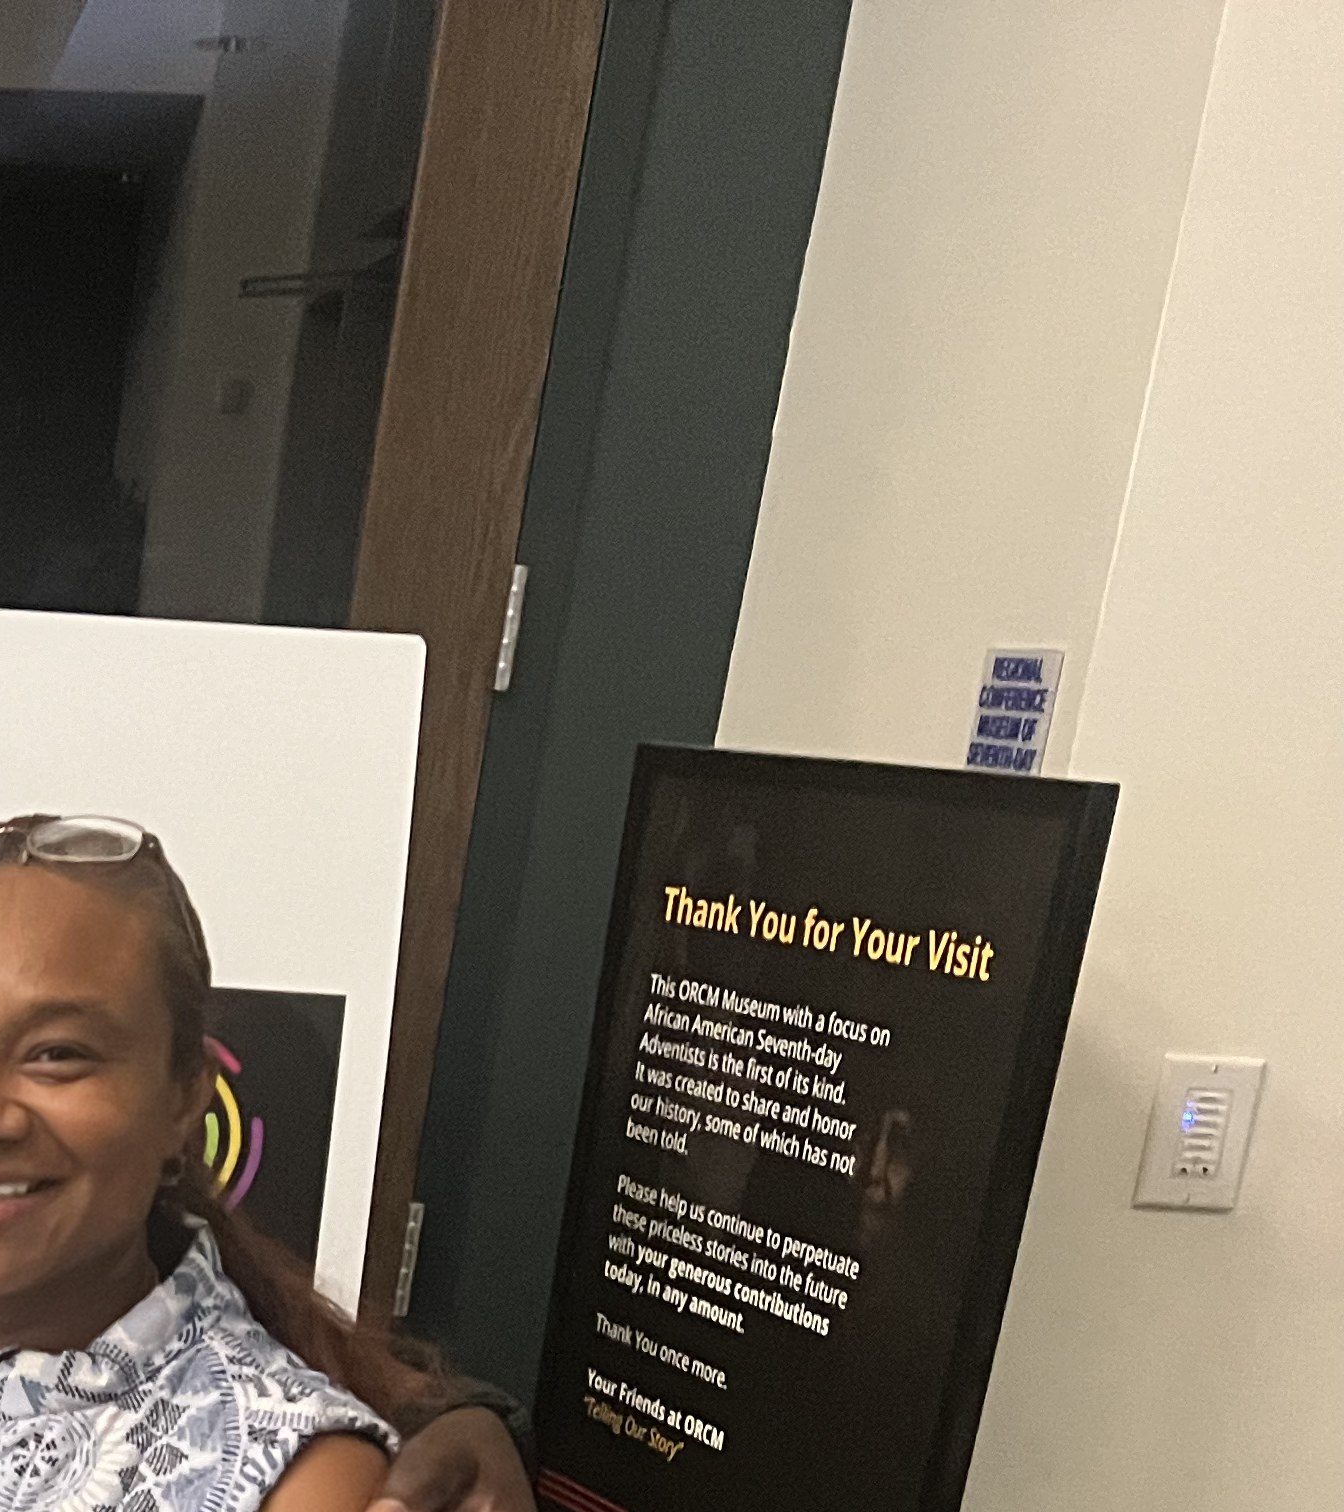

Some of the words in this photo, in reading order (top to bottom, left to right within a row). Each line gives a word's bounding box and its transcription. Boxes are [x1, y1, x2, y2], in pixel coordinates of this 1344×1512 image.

[665, 886, 742, 934] Thank
[749, 900, 797, 944] You
[802, 907, 844, 952] for
[853, 917, 920, 966] Your
[929, 929, 994, 981] Visit
[644, 1003, 690, 1032] African
[691, 1014, 754, 1048] American
[756, 1029, 842, 1075] Seventh-day
[651, 973, 677, 998] This
[679, 979, 720, 1008] ORCM
[722, 988, 781, 1022] Museum
[782, 1003, 812, 1029] with
[815, 1013, 825, 1033] a
[828, 1011, 868, 1042] focus
[870, 1026, 891, 1047] on
[635, 1061, 645, 1082] It
[647, 1067, 673, 1088] was
[674, 1074, 724, 1102] created
[725, 1087, 740, 1108] to
[741, 1090, 780, 1120] share
[782, 1104, 811, 1128] and
[812, 1107, 857, 1141] honor
[639, 1031, 706, 1067] Adventists
[708, 1048, 719, 1071] is
[722, 1052, 744, 1077] the
[746, 1057, 773, 1086] first
[775, 1067, 793, 1090] of
[793, 1069, 810, 1095] its
[812, 1075, 846, 1105] kind.
[626, 1115, 658, 1146] been
[660, 1129, 688, 1155] told.
[630, 1093, 654, 1113] our
[655, 1095, 701, 1132] history,
[705, 1114, 741, 1140] some
[743, 1123, 760, 1145] of
[760, 1129, 800, 1159] which
[802, 1138, 828, 1166] has
[830, 1151, 856, 1176] not
[613, 1202, 647, 1232] these
[648, 1219, 703, 1253] priceless
[705, 1239, 749, 1270] stories
[750, 1253, 777, 1281] into
[780, 1265, 802, 1292] the
[805, 1272, 848, 1310] future
[617, 1174, 658, 1206] Please
[660, 1188, 688, 1220] help
[689, 1202, 706, 1223] us
[707, 1209, 764, 1244] continue
[766, 1227, 780, 1249] to
[782, 1236, 860, 1280] perpetuate
[604, 1259, 644, 1294] today,
[647, 1273, 660, 1298] in
[662, 1284, 688, 1313] any
[689, 1296, 744, 1334] amount.
[608, 1234, 635, 1257] with
[636, 1245, 668, 1268] your
[668, 1257, 732, 1295] generous
[734, 1282, 830, 1336] contributions
[597, 1312, 633, 1346] Thank
[635, 1329, 658, 1357] You
[660, 1345, 689, 1372] once
[691, 1359, 727, 1390] more.
[587, 1367, 617, 1397] Your
[619, 1382, 665, 1421] Friends
[667, 1409, 682, 1429] at
[684, 1414, 724, 1451] ORCM
[625, 1416, 648, 1441] Our
